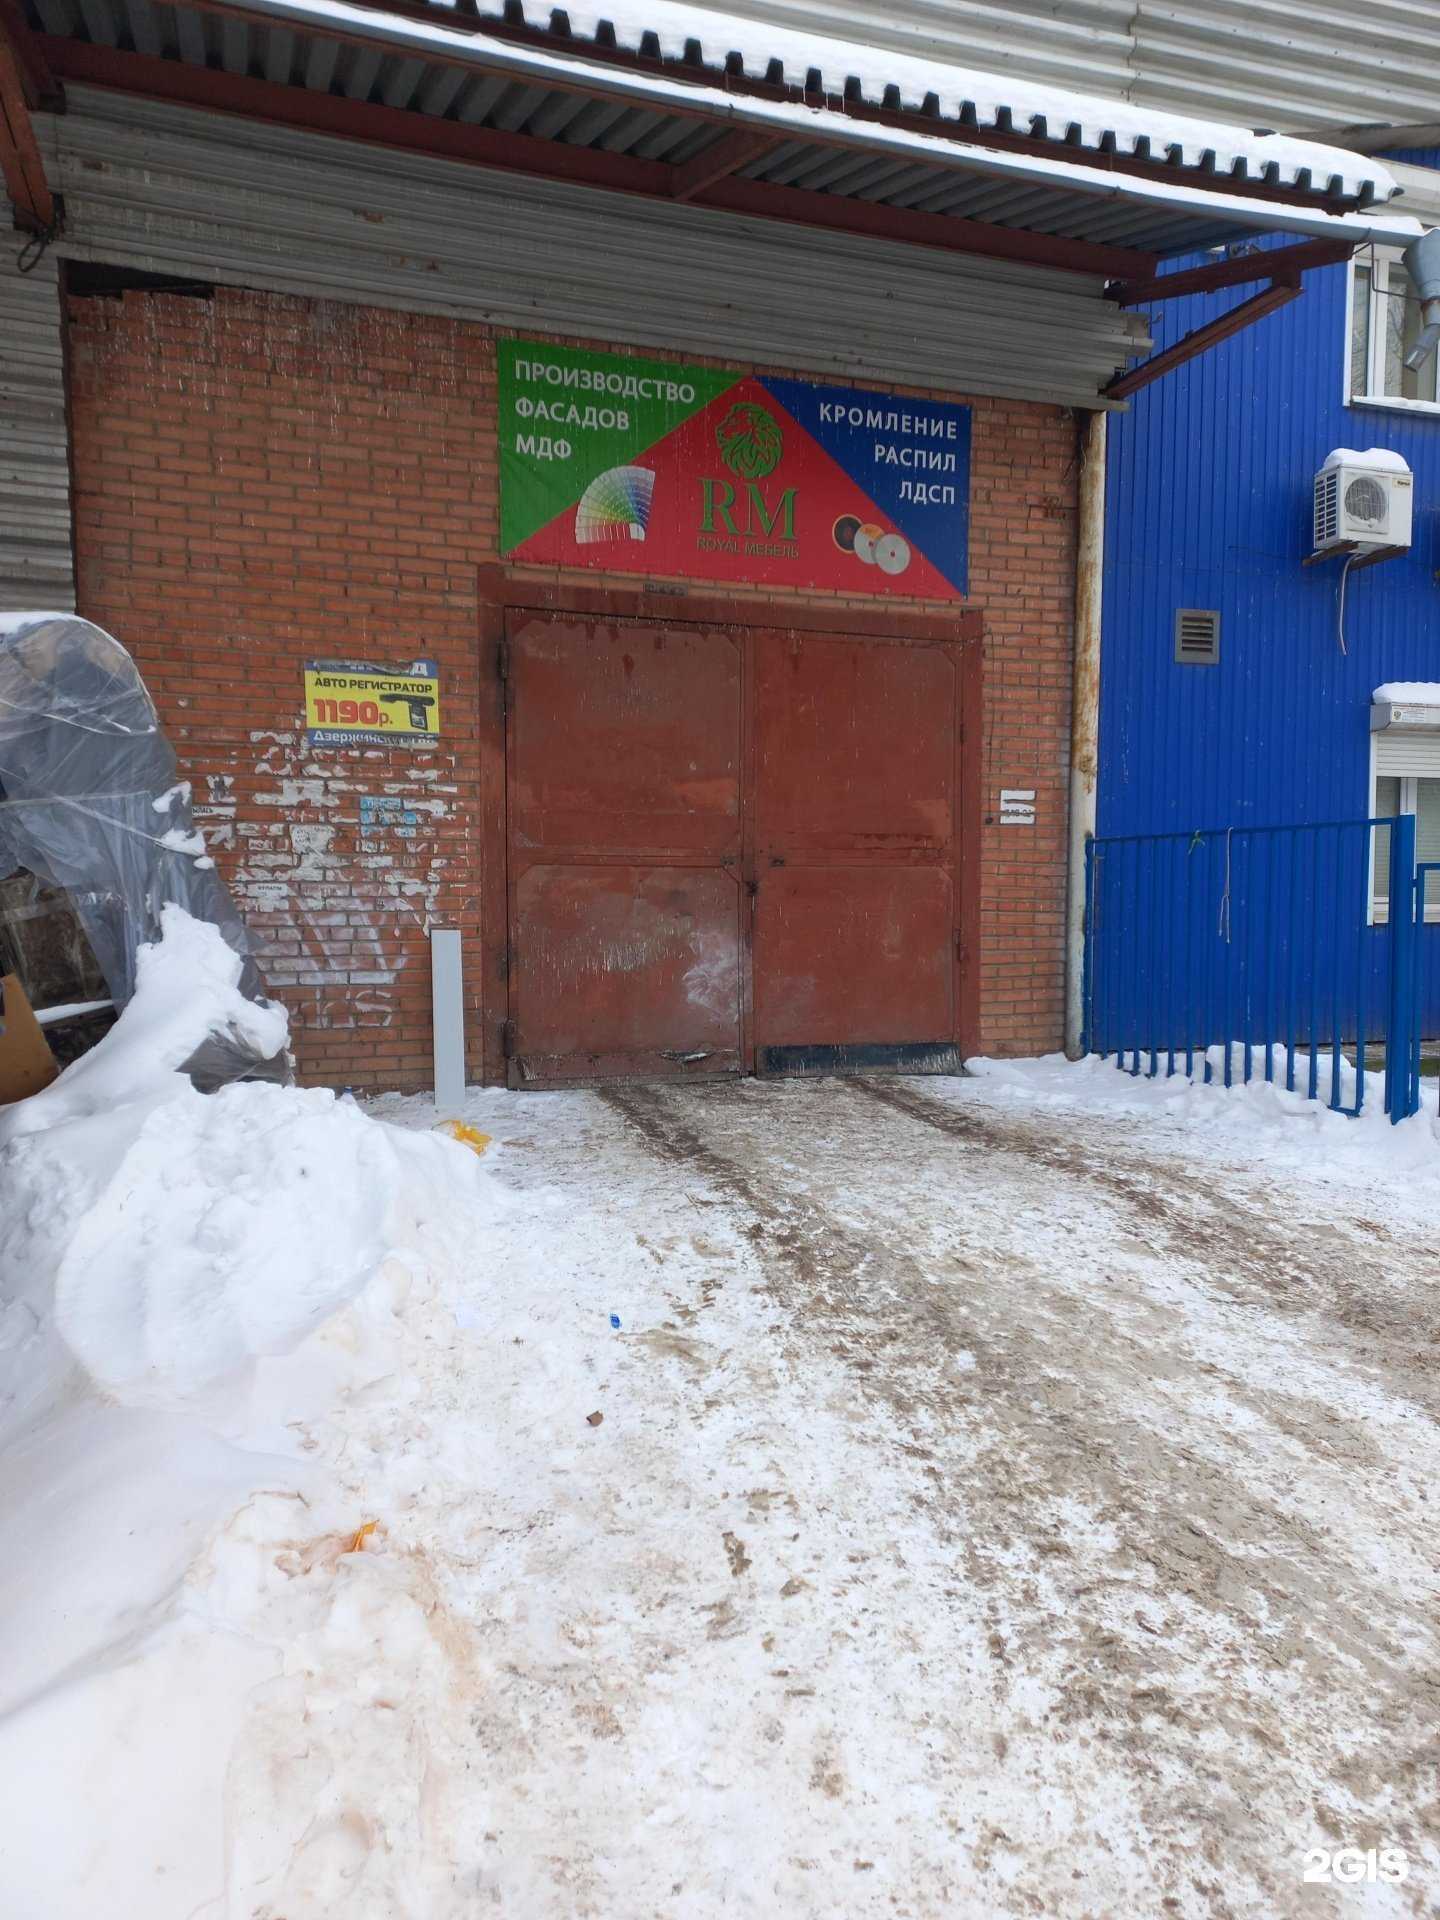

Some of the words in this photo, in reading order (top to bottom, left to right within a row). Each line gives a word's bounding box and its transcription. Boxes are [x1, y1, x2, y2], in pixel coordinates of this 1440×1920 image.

[514, 359, 696, 404] ПРОИЗВОДСТВО
[514, 397, 630, 431] ФАСАДОВ
[819, 402, 958, 440] КРОМЛЕНИЕ
[515, 433, 573, 461] МДФ
[874, 444, 956, 472] РАСПИЛ
[898, 481, 956, 505] ЛДСП
[697, 477, 799, 541] RM
[696, 536, 741, 554] ROYAL
[744, 542, 800, 561] МЕБЕЛЬ
[314, 677, 348, 689] АВТО
[349, 680, 433, 693] РЕГИСТРАТОР
